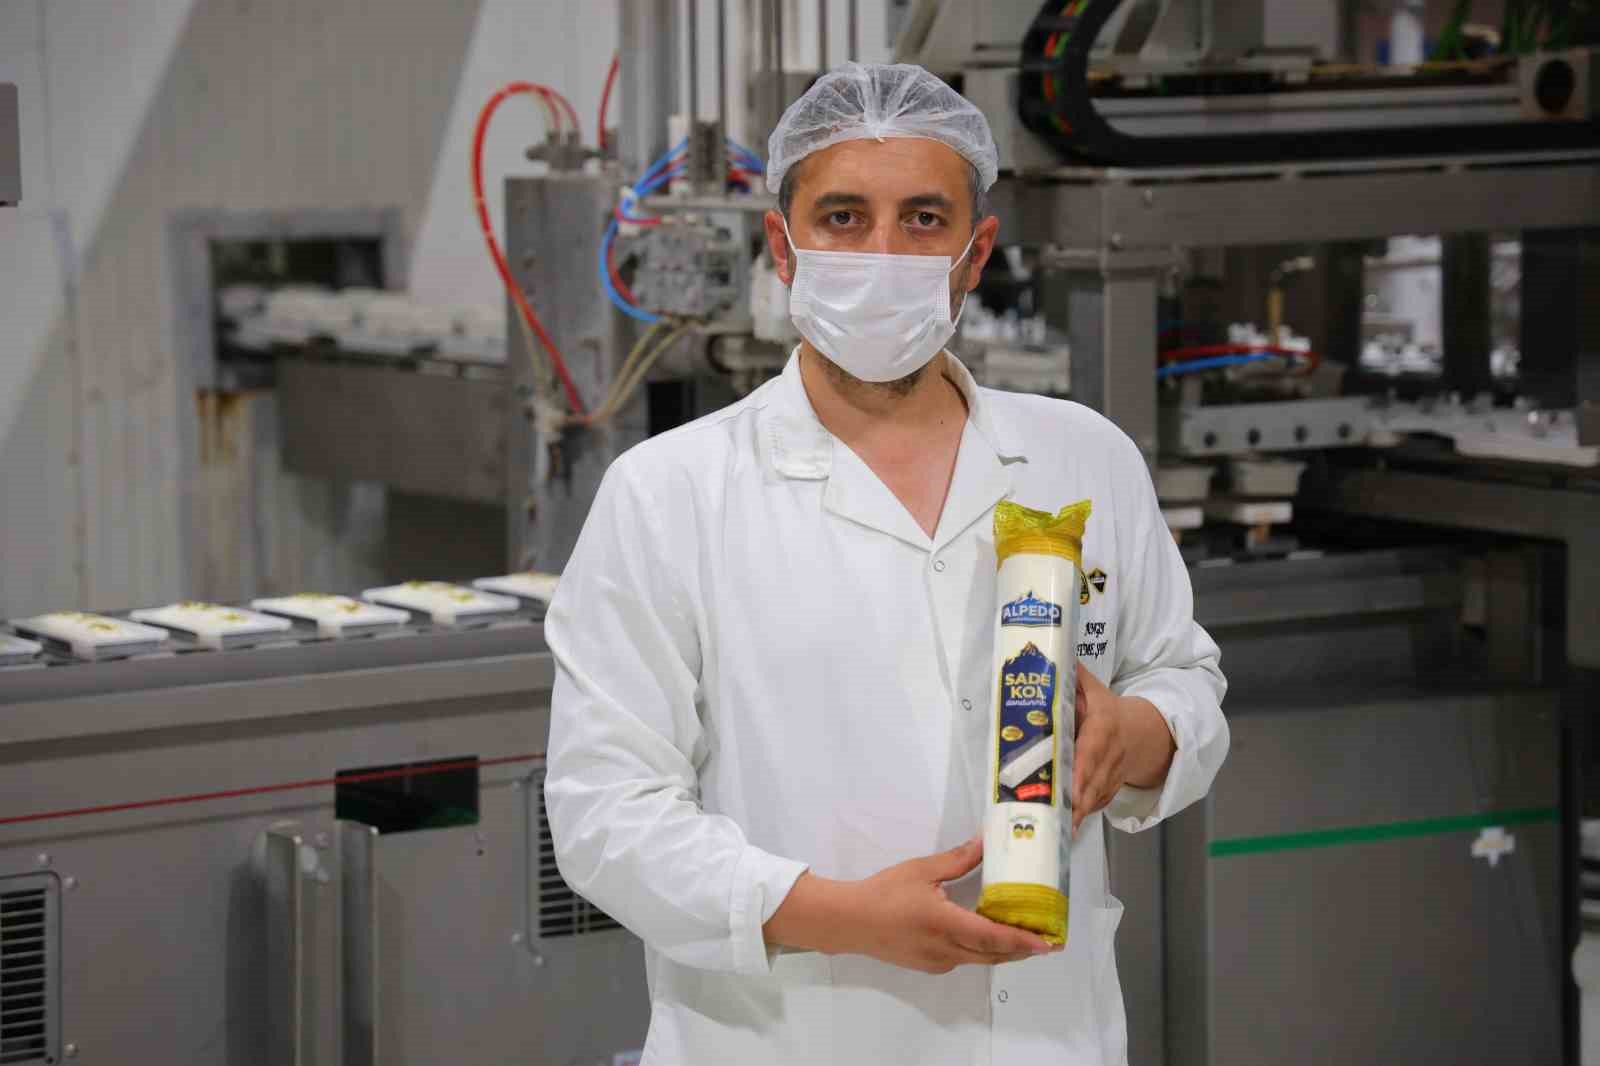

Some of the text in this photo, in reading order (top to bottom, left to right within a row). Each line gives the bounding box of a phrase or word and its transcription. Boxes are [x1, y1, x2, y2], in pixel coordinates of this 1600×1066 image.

[1003, 605, 1060, 619] ALPEDO
[1005, 672, 1051, 686] SADE
[1010, 686, 1046, 699] KOL
